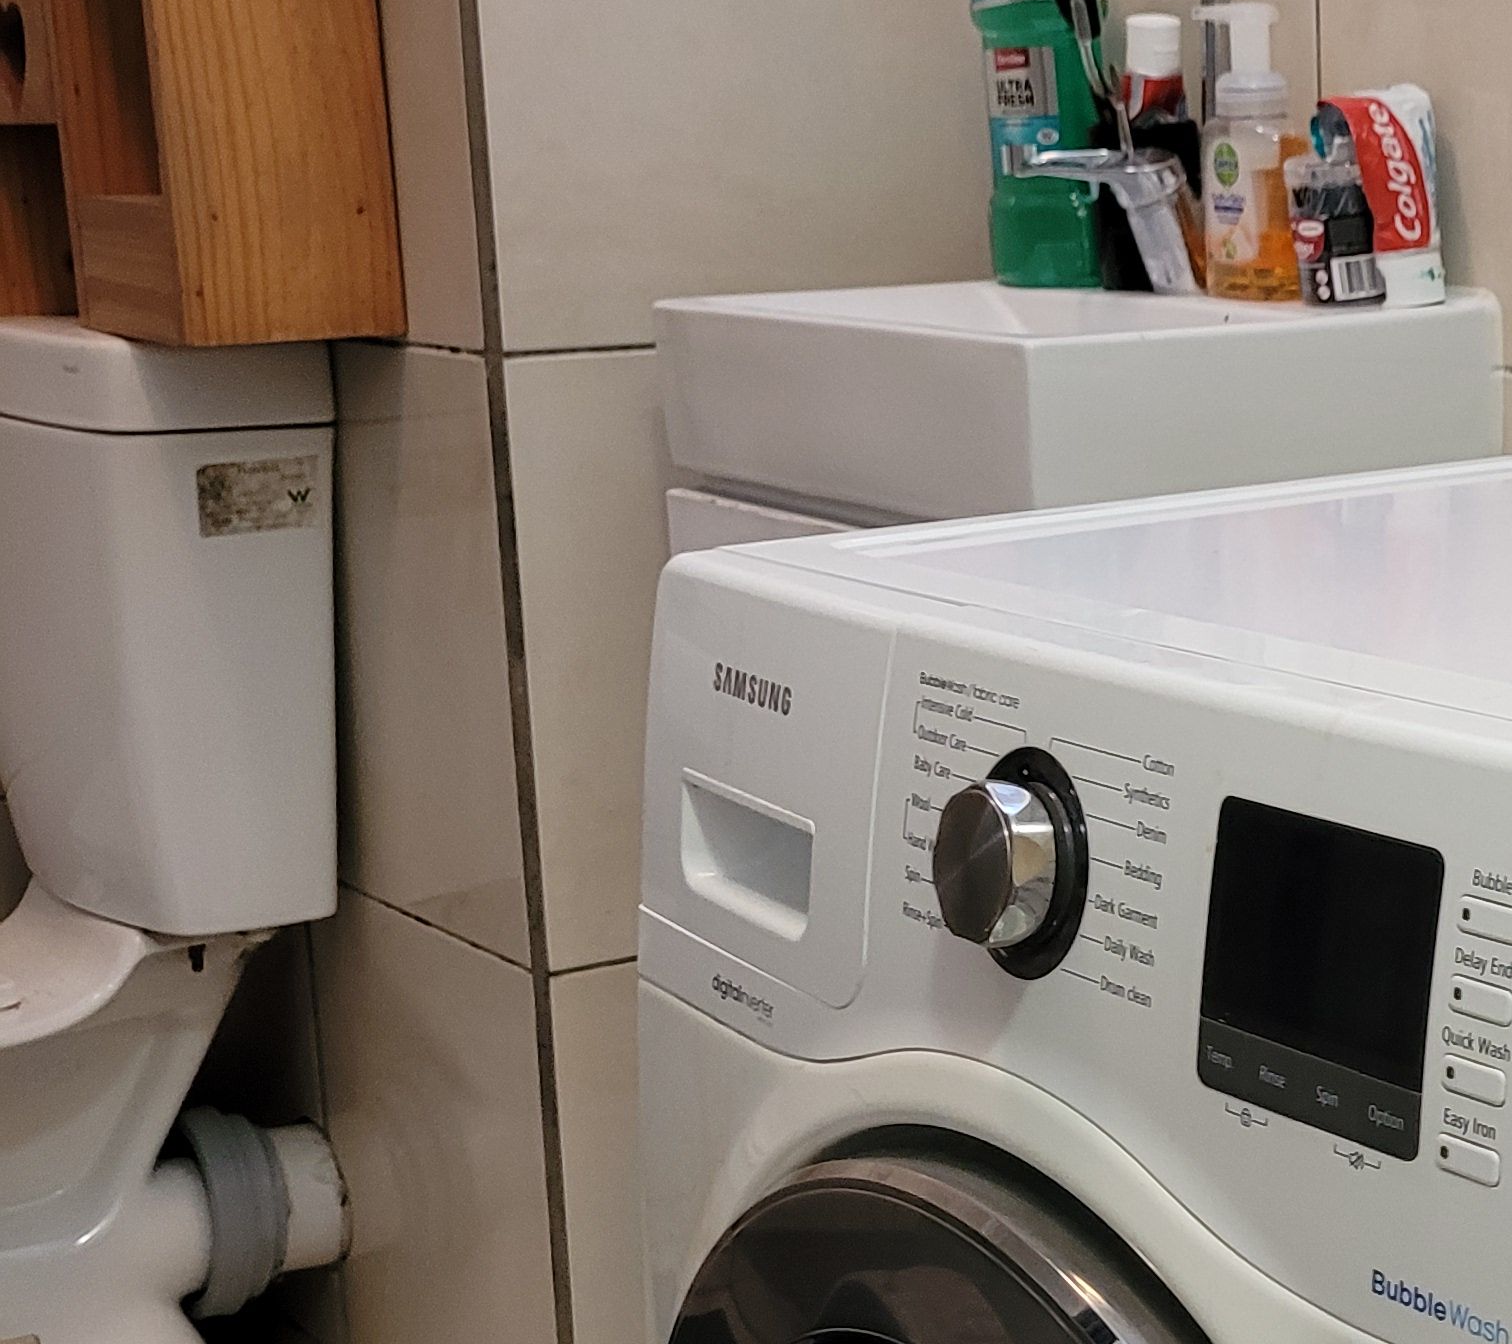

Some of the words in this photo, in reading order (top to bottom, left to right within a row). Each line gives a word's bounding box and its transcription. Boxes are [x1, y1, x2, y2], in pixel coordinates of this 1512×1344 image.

[1368, 102, 1422, 241] Colgate
[713, 662, 792, 716] SAMSUNG
[1123, 859, 1162, 890] Bedding
[1117, 901, 1158, 929] Garment
[1454, 947, 1487, 976] Delay
[1441, 1025, 1474, 1052] Quick
[1477, 1036, 1512, 1062] Wash
[1367, 1104, 1405, 1131] Option
[1443, 1107, 1470, 1135] Easy
[1472, 1118, 1497, 1140] Iron
